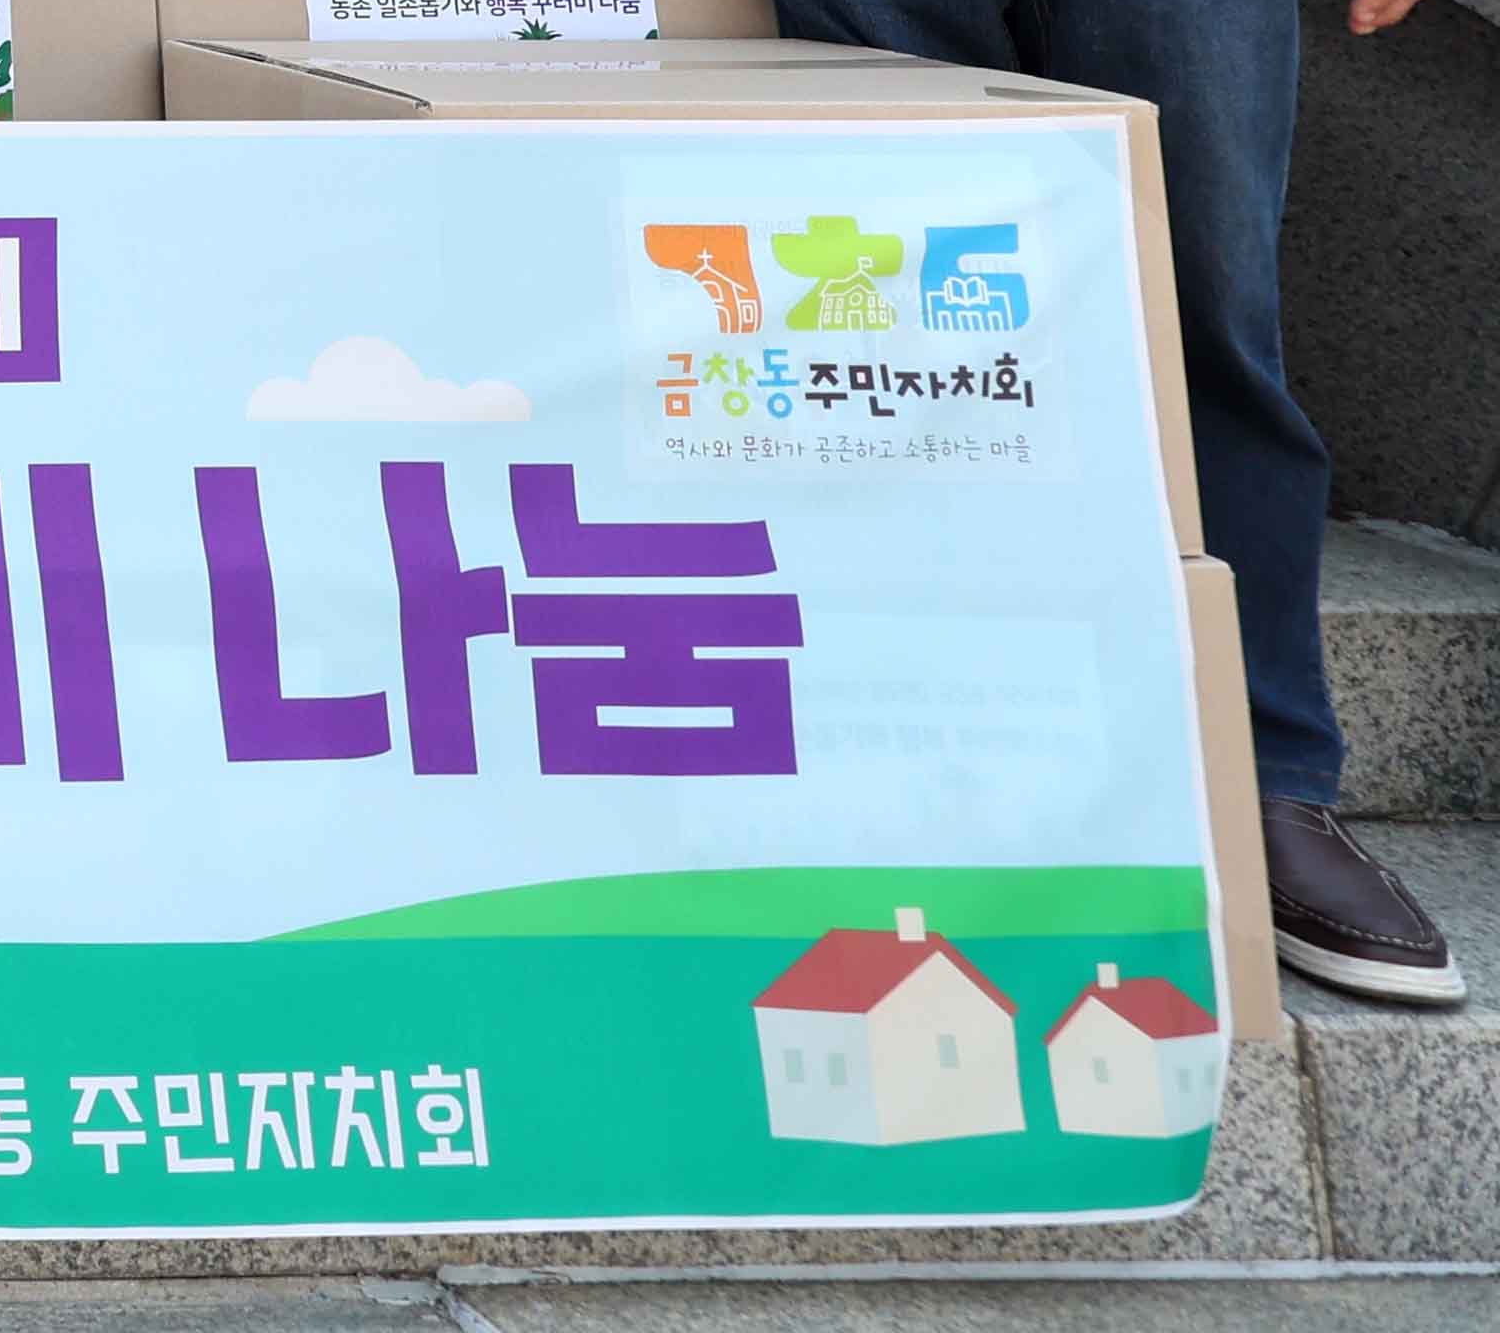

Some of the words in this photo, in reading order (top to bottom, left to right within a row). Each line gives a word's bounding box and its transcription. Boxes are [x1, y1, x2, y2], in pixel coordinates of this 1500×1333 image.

[666, 436, 732, 460] 역사와
[741, 436, 804, 462] 문화가
[814, 435, 894, 463] 공존하고
[904, 435, 981, 462] 소통하는
[991, 435, 1031, 463] 마을
[195, 462, 803, 776] 나눔
[71, 1066, 487, 1173] 주민자치회
